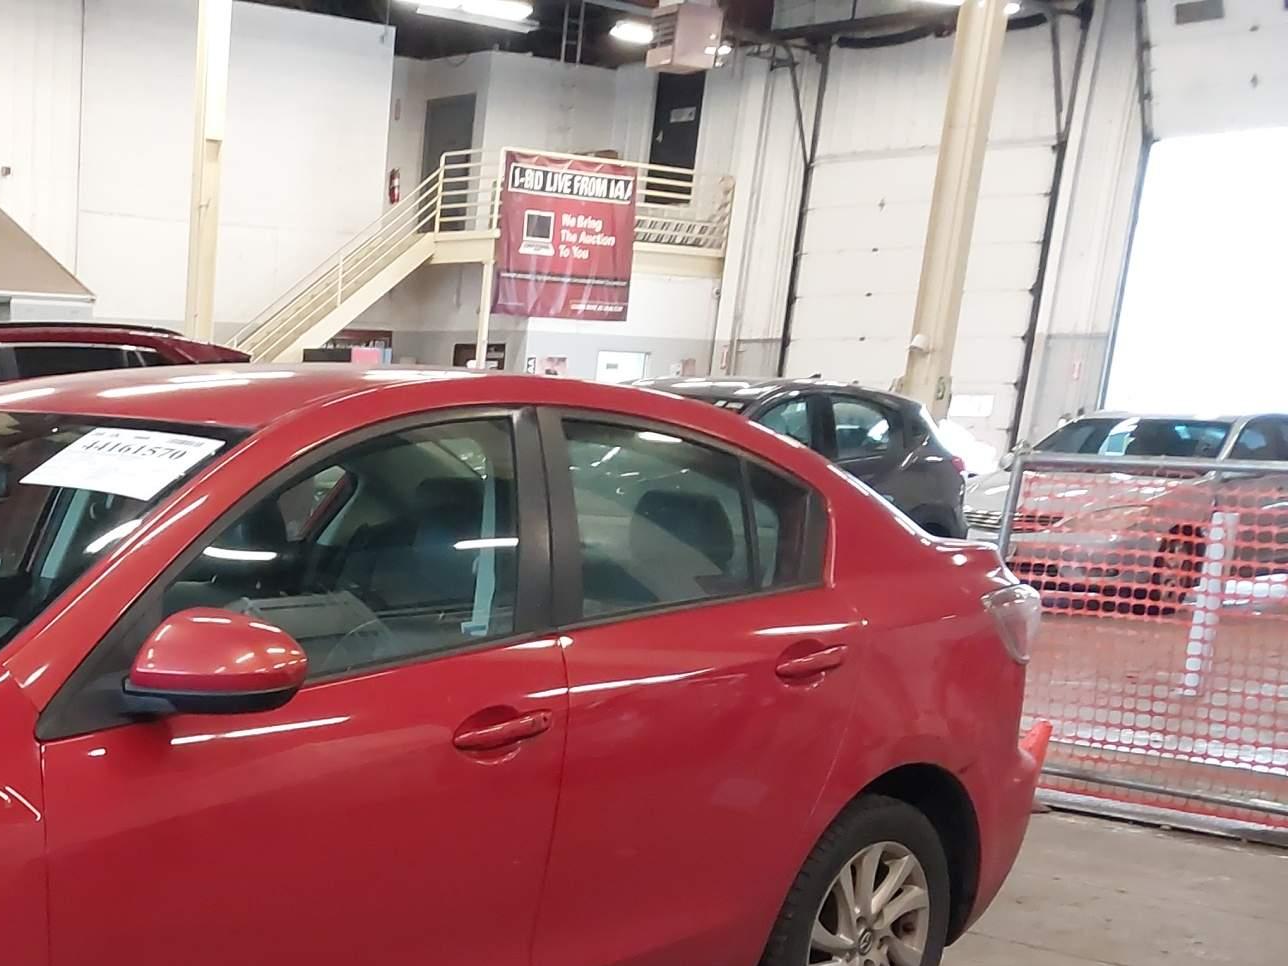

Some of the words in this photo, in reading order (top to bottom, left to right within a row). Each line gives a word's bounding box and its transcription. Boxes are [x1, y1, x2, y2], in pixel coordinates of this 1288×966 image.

[545, 172, 572, 193] LIVE
[572, 174, 608, 197] FROM
[561, 213, 576, 227] We
[576, 215, 603, 232] Bring
[560, 229, 577, 243] The
[577, 231, 616, 247] Auction
[558, 244, 570, 258] To
[571, 246, 590, 260] You
[83, 440, 187, 460] 44161570
